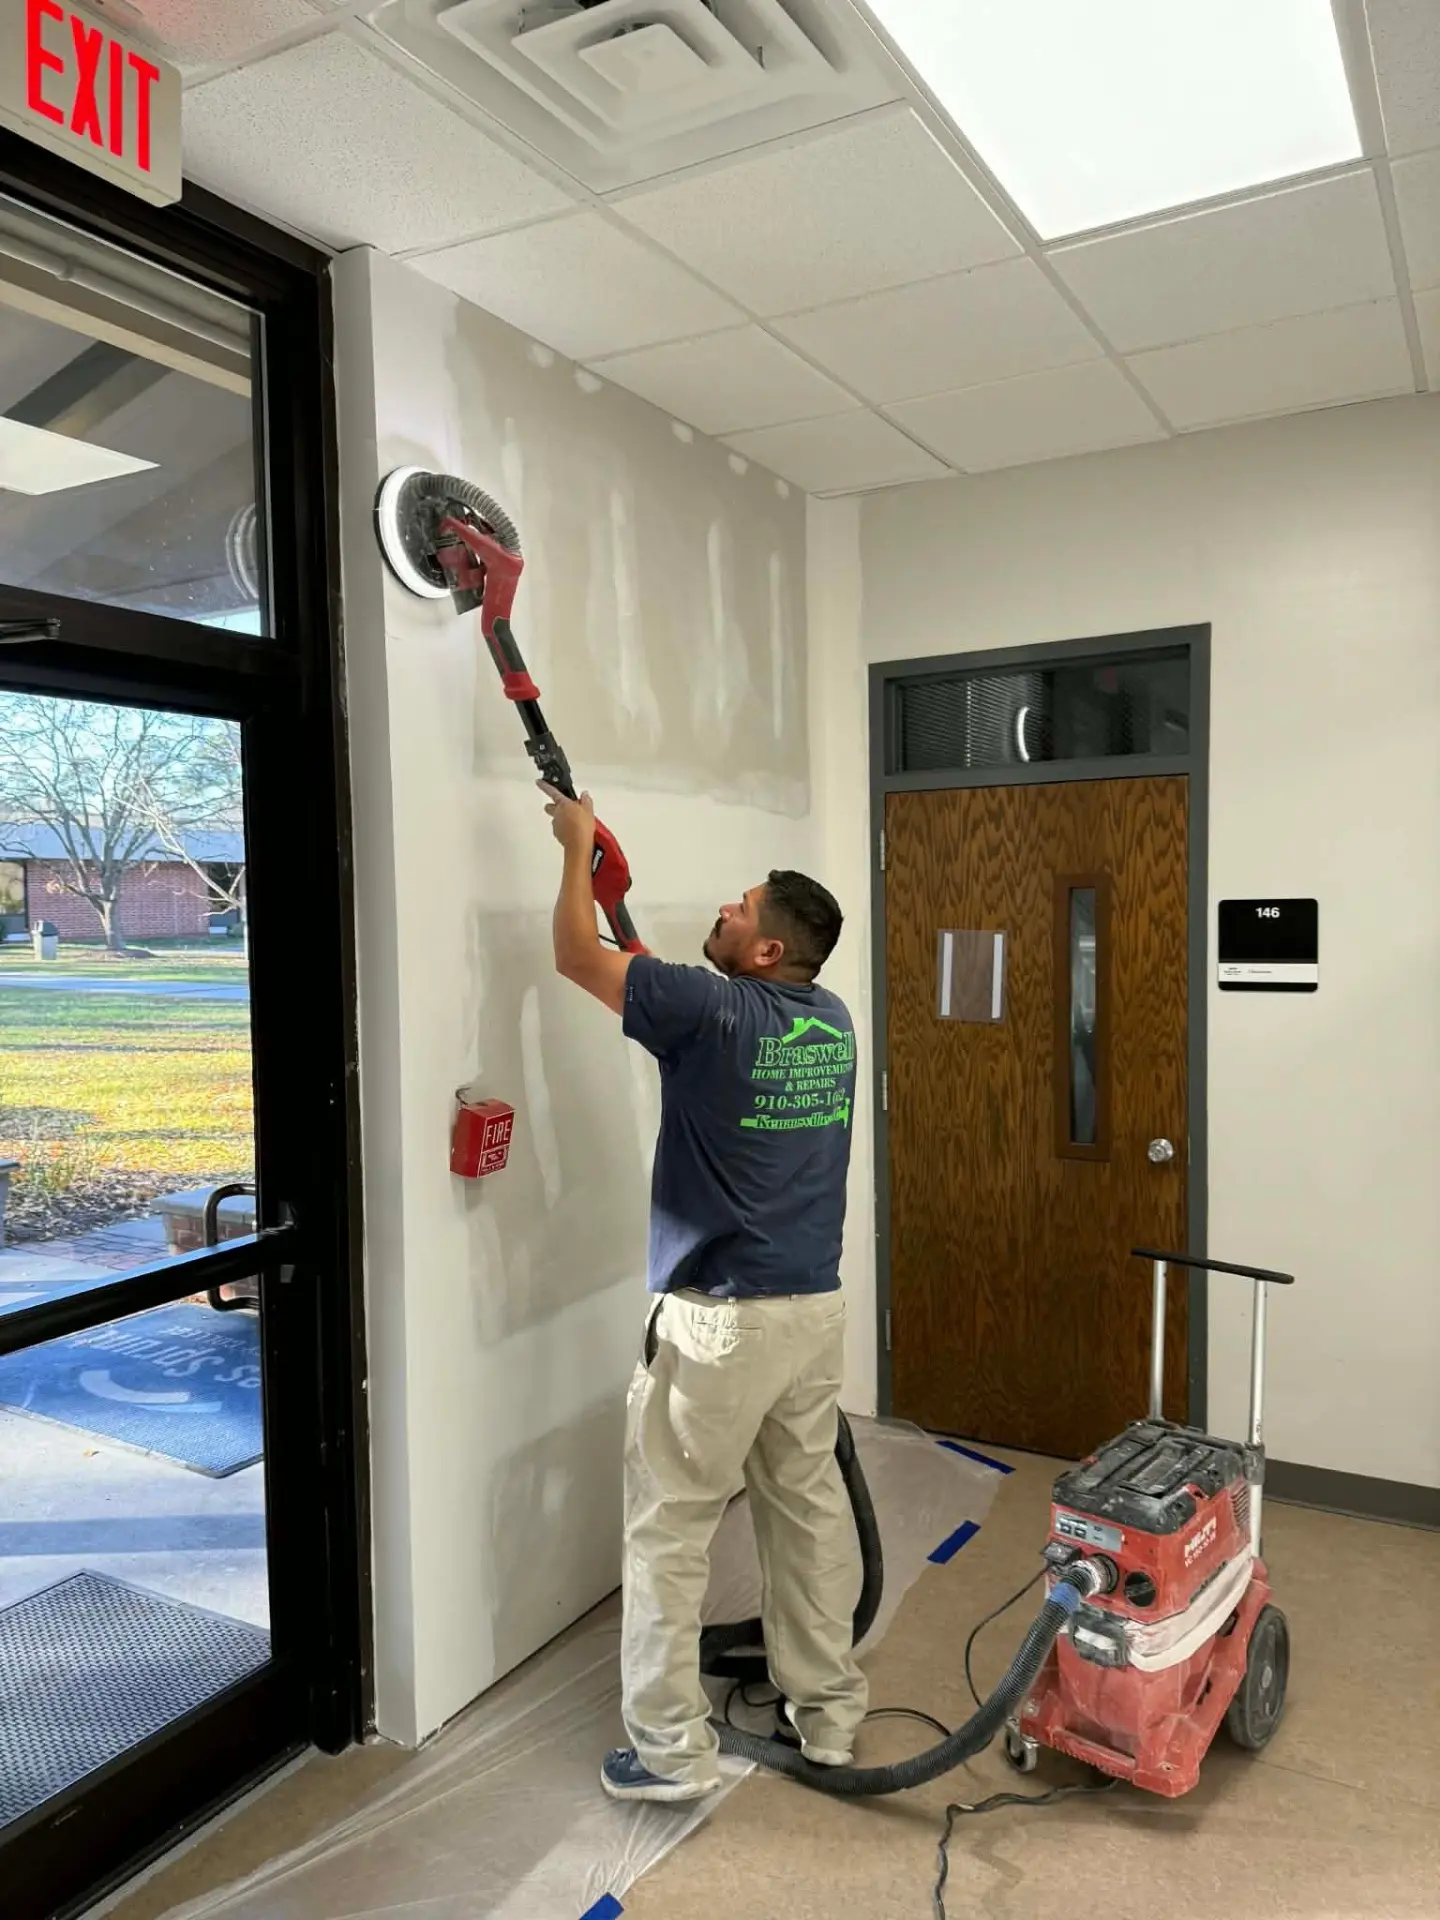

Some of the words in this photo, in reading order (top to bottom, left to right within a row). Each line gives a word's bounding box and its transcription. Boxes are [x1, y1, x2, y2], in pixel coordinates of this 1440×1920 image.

[27, 0, 160, 172] EXIT
[1255, 906, 1281, 918] 146
[751, 1068, 786, 1080] HOME
[785, 1081, 794, 1092] &
[797, 1077, 837, 1091] REPAIRS
[484, 1119, 511, 1148] FIRE
